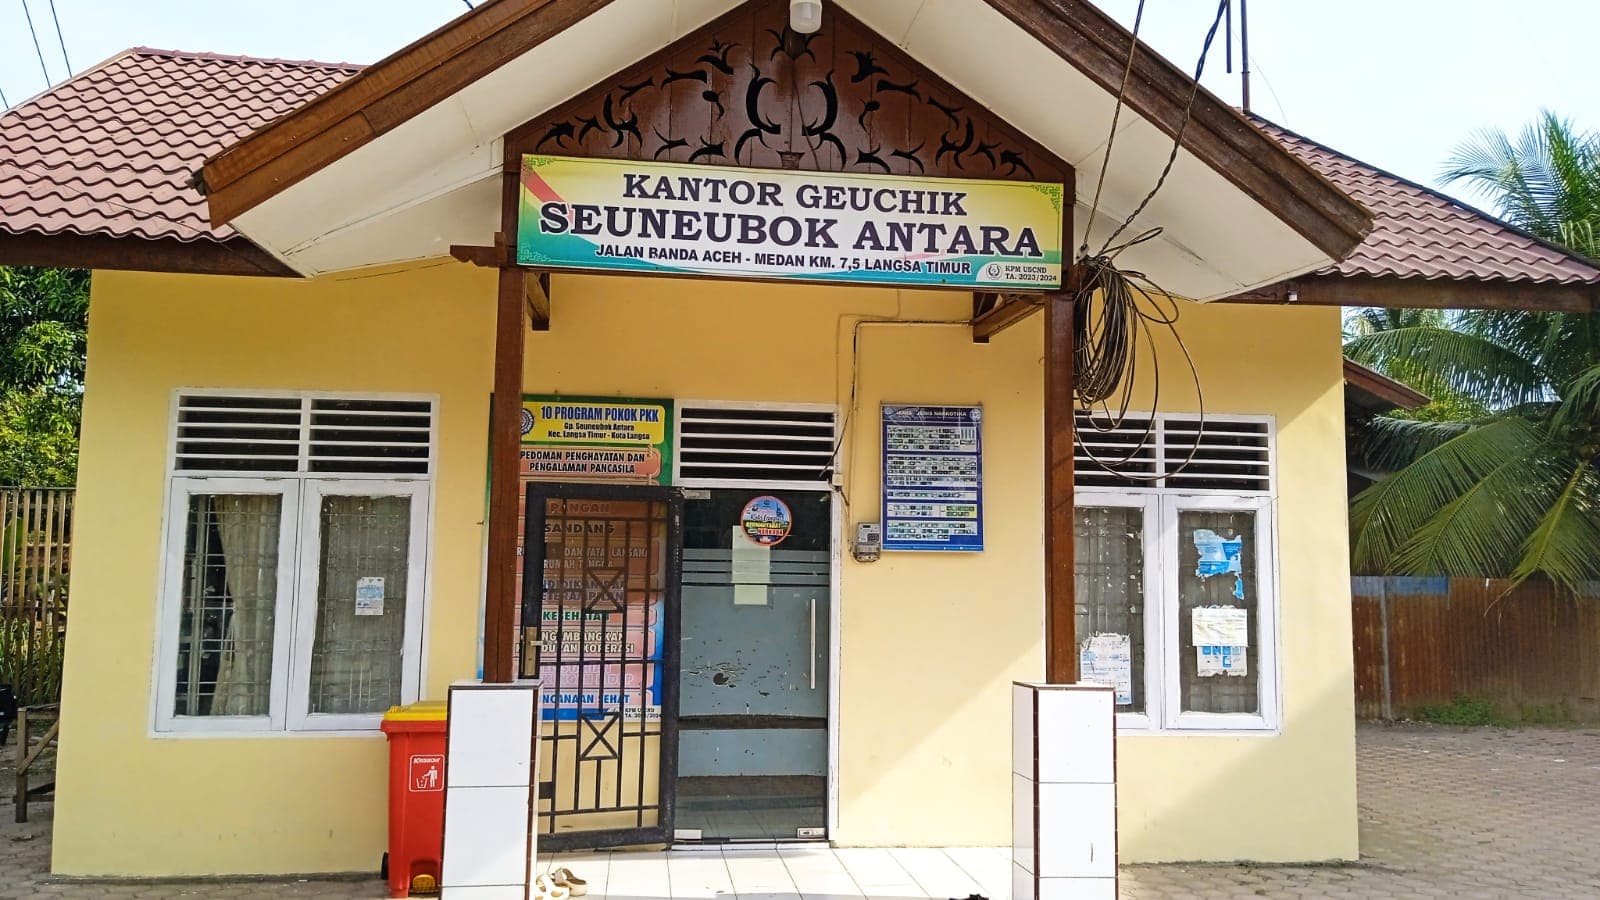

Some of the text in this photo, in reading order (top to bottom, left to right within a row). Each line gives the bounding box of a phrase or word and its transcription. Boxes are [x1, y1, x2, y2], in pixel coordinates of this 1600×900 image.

[623, 174, 968, 216] KANTOR GEUCHIK
[540, 203, 1043, 257] SEUNEUBOK ANTARA
[596, 244, 644, 258] JALAN
[702, 250, 741, 264] ACEH
[755, 253, 806, 267] MEDAN
[809, 256, 836, 269] KM.
[840, 257, 860, 271] 7,5
[865, 258, 921, 273] LANGSA
[925, 261, 971, 274] TIMUR
[1005, 265, 1021, 273] KPM
[541, 406, 659, 422] 10 PROGRAM POKOK PKK
[520, 451, 645, 462] PEDOMAN PENGHAYATAN DAN
[530, 462, 635, 473] PENGALAMAN PANCASILA
